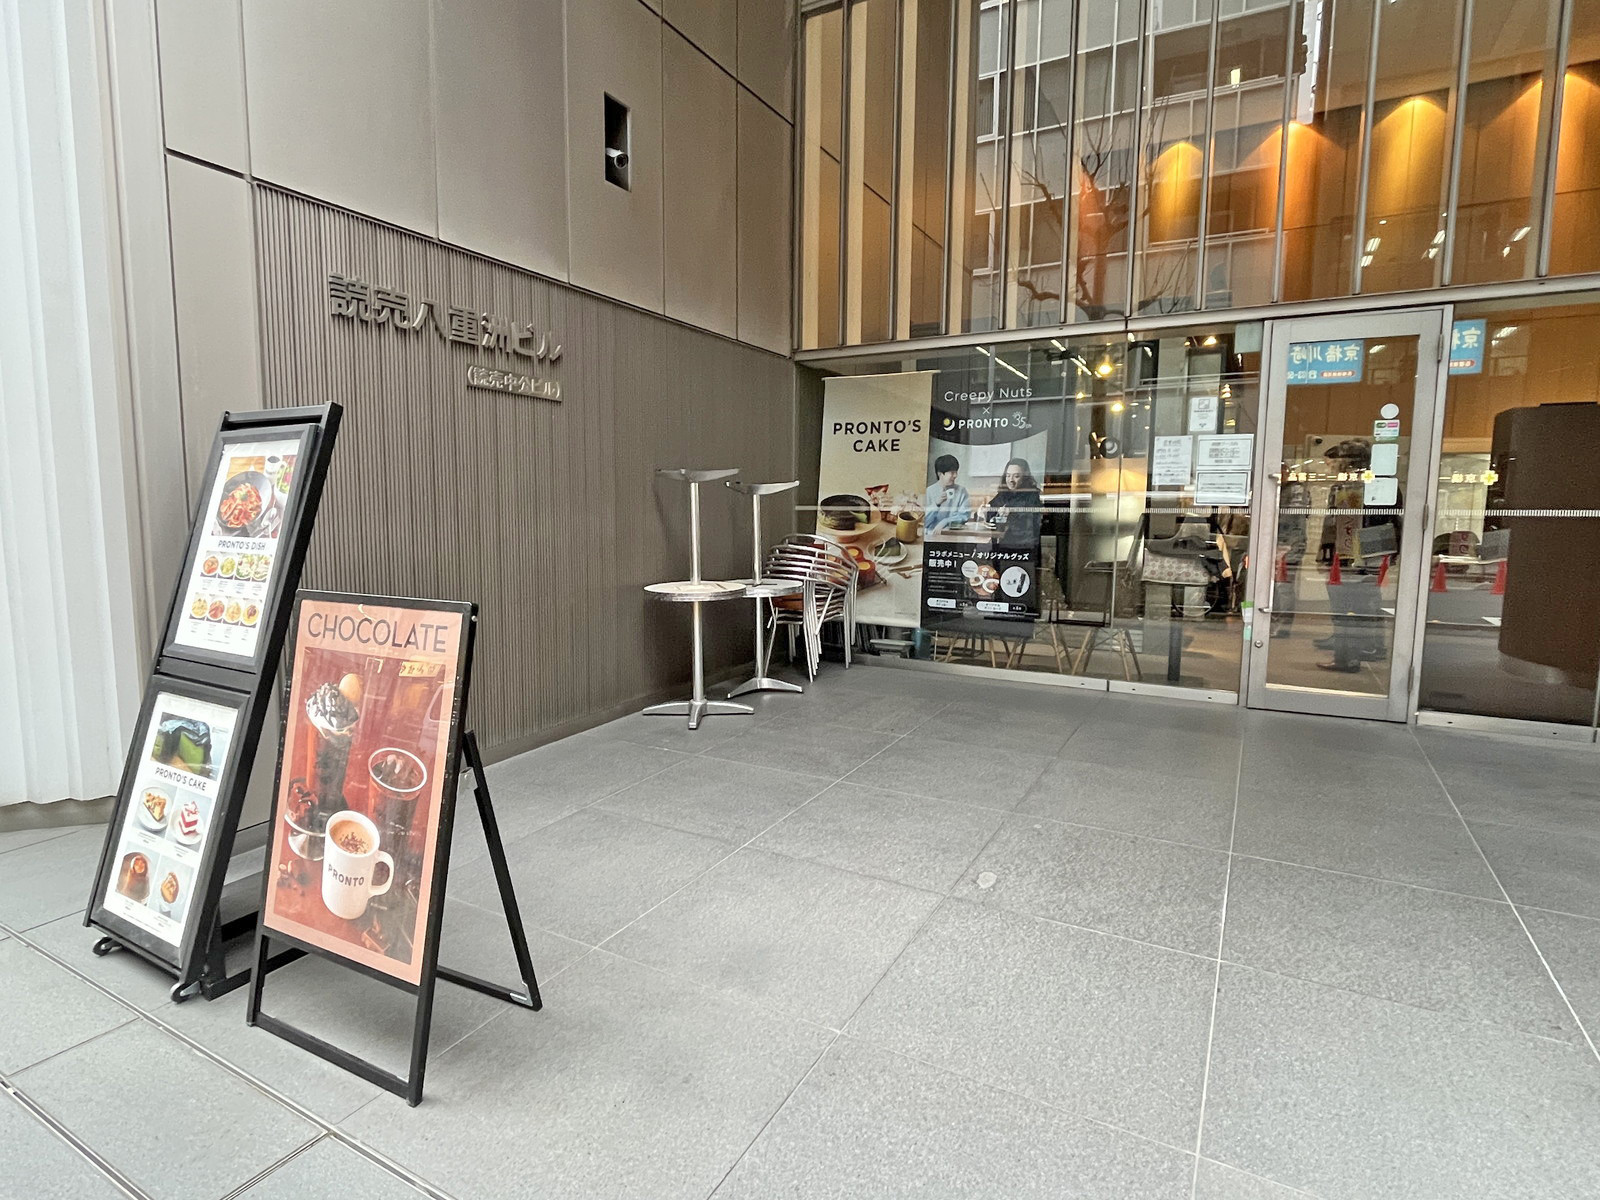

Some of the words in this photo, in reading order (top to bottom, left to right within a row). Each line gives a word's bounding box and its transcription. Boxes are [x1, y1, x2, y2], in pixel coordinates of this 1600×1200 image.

[328, 271, 562, 361] 読売八重洲ビル
[944, 390, 994, 403] Creepy
[999, 387, 1033, 398] Nuts
[958, 417, 1009, 429] PRONTO
[853, 439, 900, 452] CAKE
[251, 542, 266, 551] DISH
[307, 612, 449, 653] CHOCOLATE
[189, 778, 207, 791] CAKE
[328, 863, 365, 887] PRONTO
